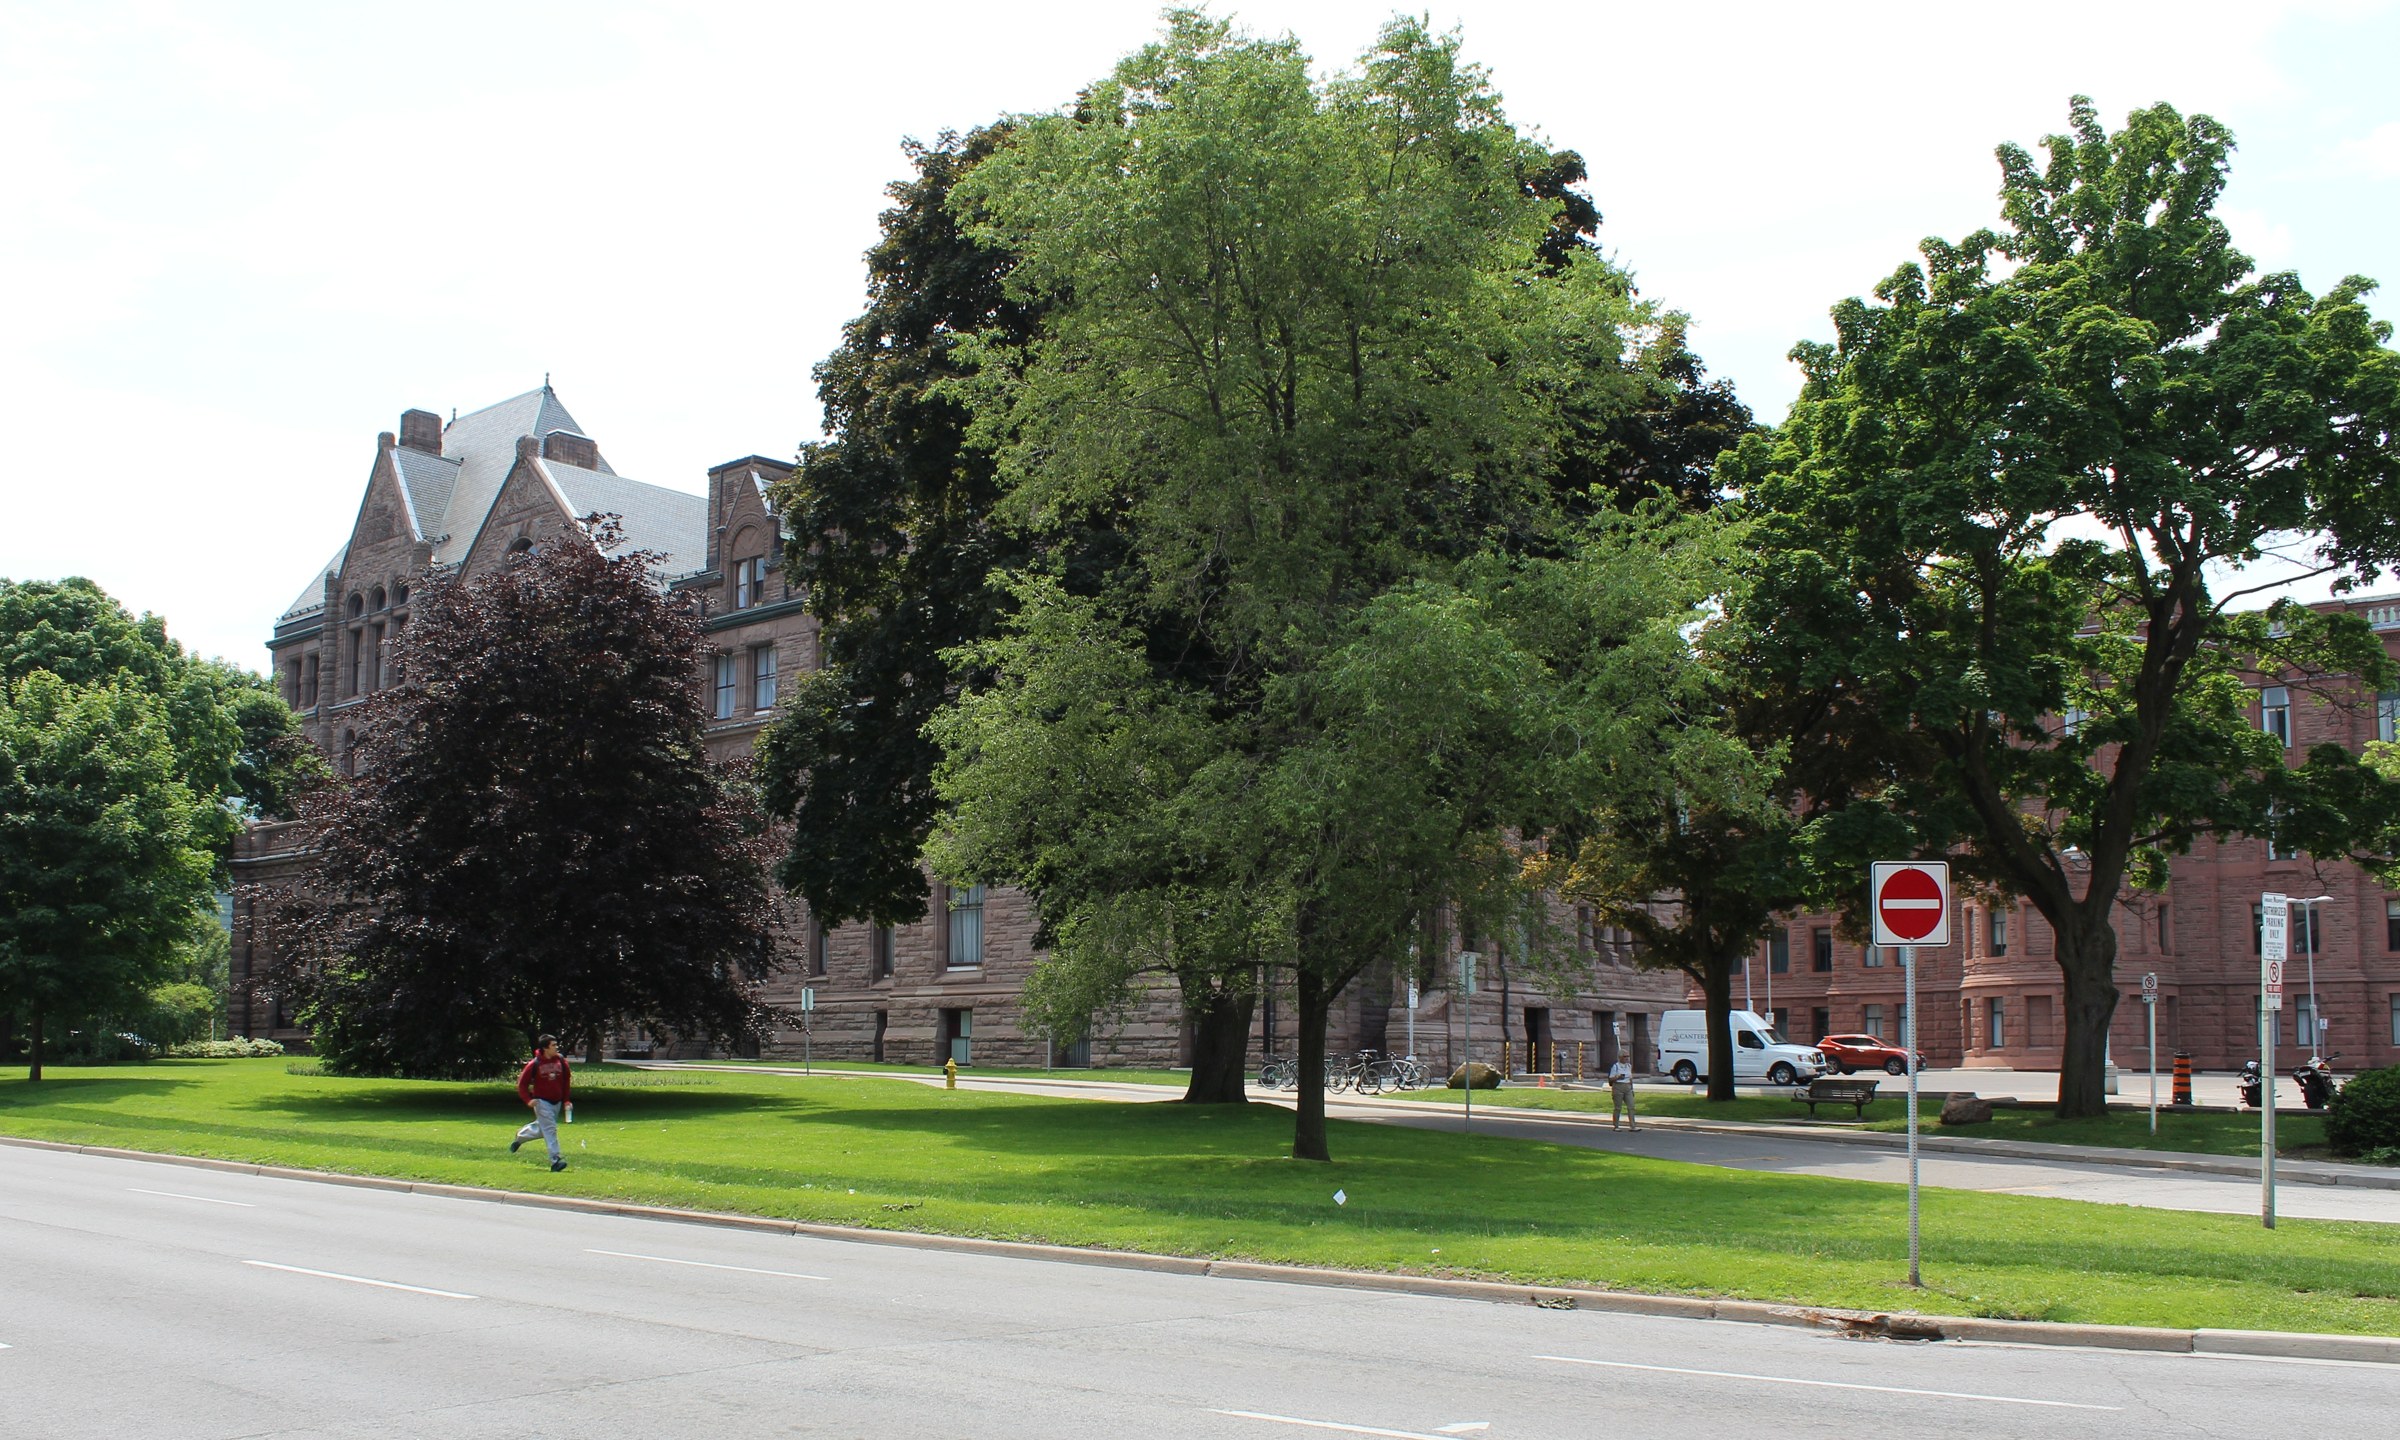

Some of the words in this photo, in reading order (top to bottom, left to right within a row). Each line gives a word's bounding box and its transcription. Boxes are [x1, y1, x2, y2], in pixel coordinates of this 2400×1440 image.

[2263, 905, 2287, 917] AUTHORIZED
[2266, 917, 2284, 928] PARKING
[2269, 929, 2280, 939] ONLY
